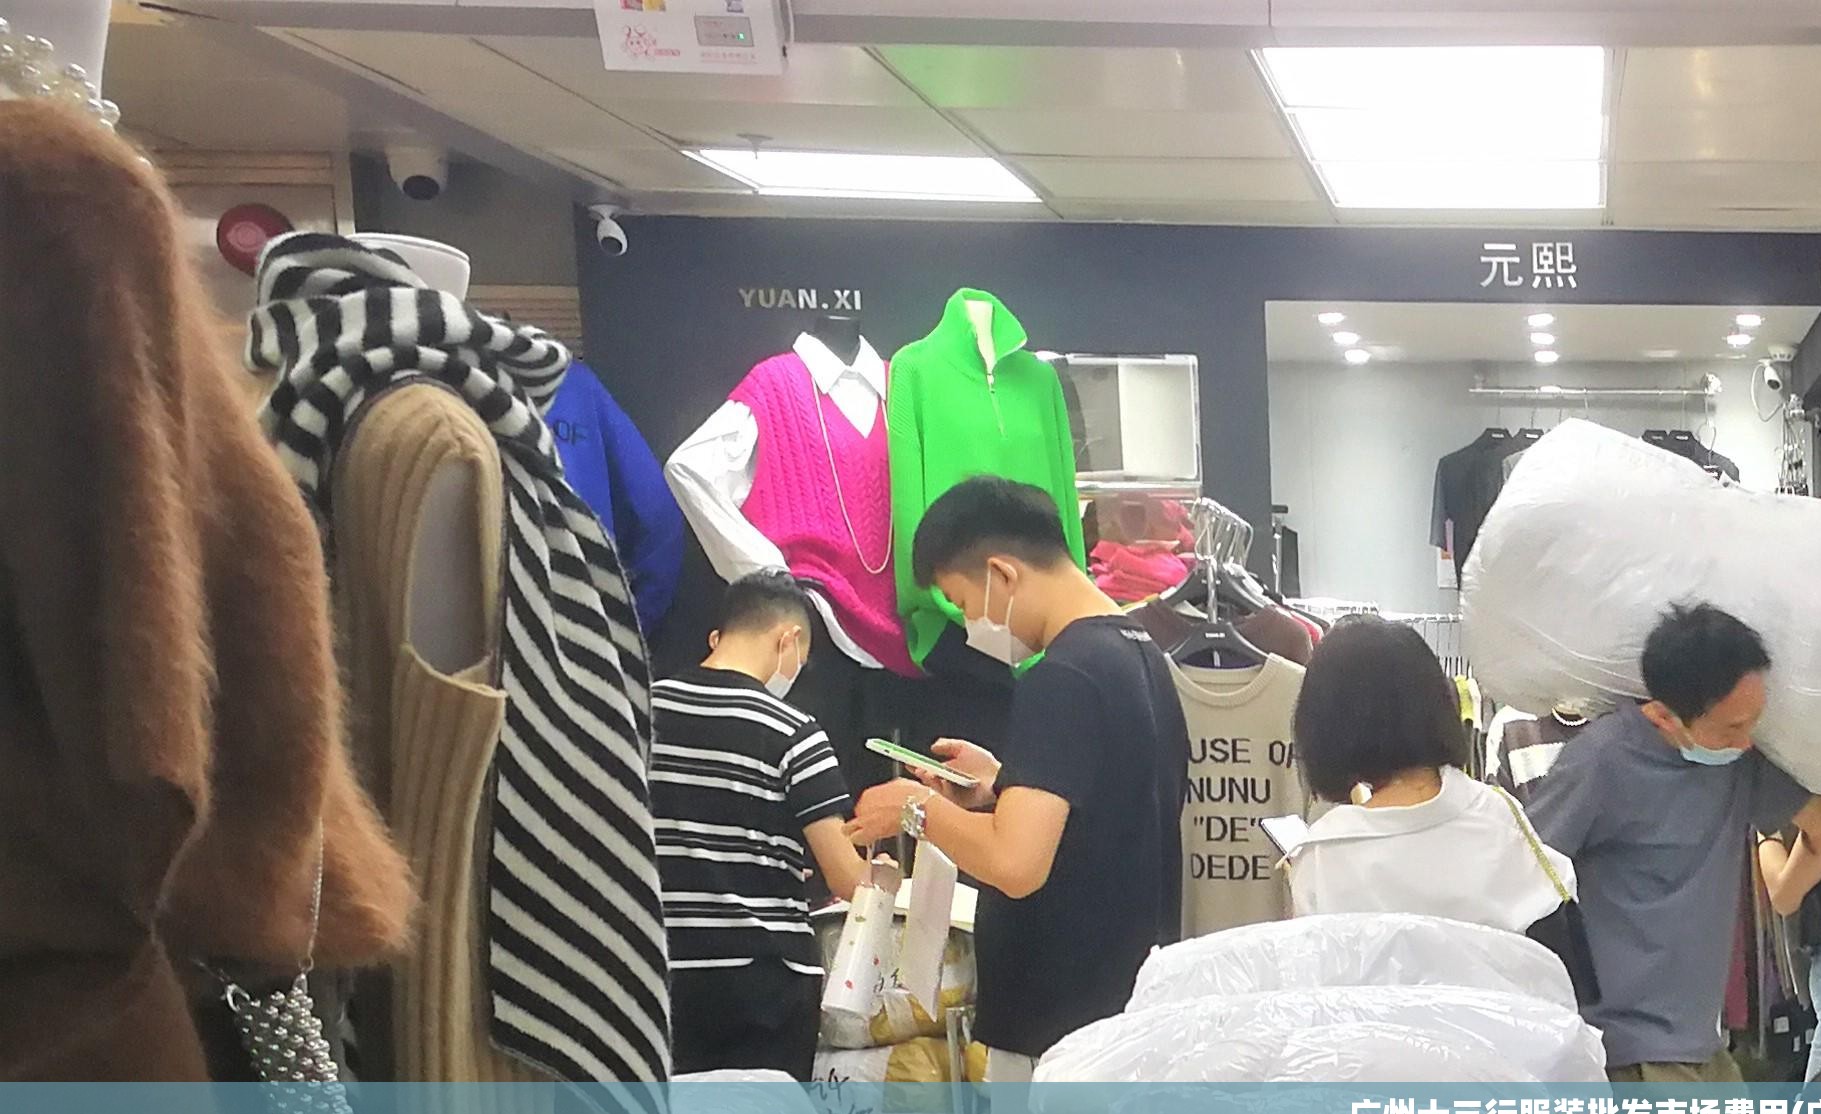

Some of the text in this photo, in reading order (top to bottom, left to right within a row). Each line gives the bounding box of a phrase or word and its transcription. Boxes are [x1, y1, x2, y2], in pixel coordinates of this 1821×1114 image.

[1480, 242, 1577, 288] 元熙
[738, 288, 862, 311] YUAN.XI
[1187, 777, 1272, 804] NUNU
[1191, 854, 1271, 881] DEDE
